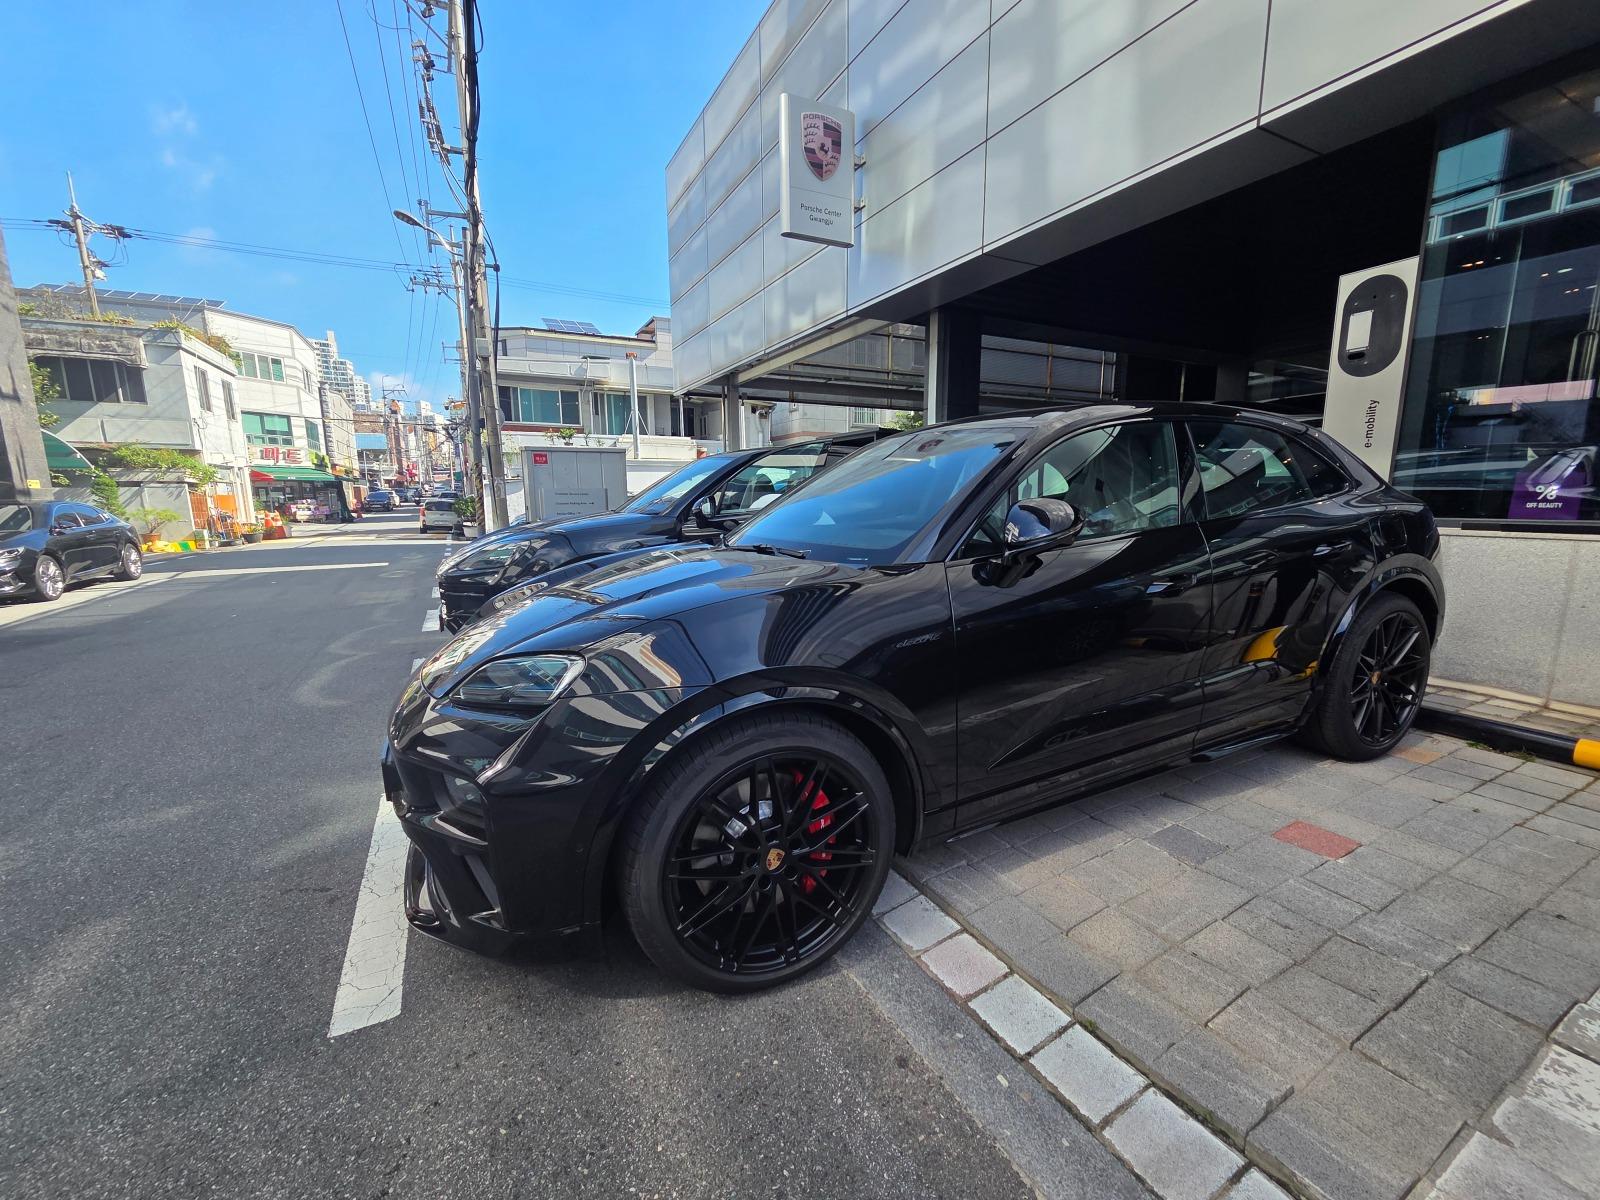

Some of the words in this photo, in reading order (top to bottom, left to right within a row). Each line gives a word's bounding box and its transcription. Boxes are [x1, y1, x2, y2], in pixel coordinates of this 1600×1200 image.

[802, 113, 842, 130] PORSCHE
[800, 202, 823, 214] Porsche
[823, 207, 842, 218] Center
[809, 214, 834, 226] Gwangju
[1364, 399, 1380, 449] e-mobility
[261, 447, 303, 465] 마트
